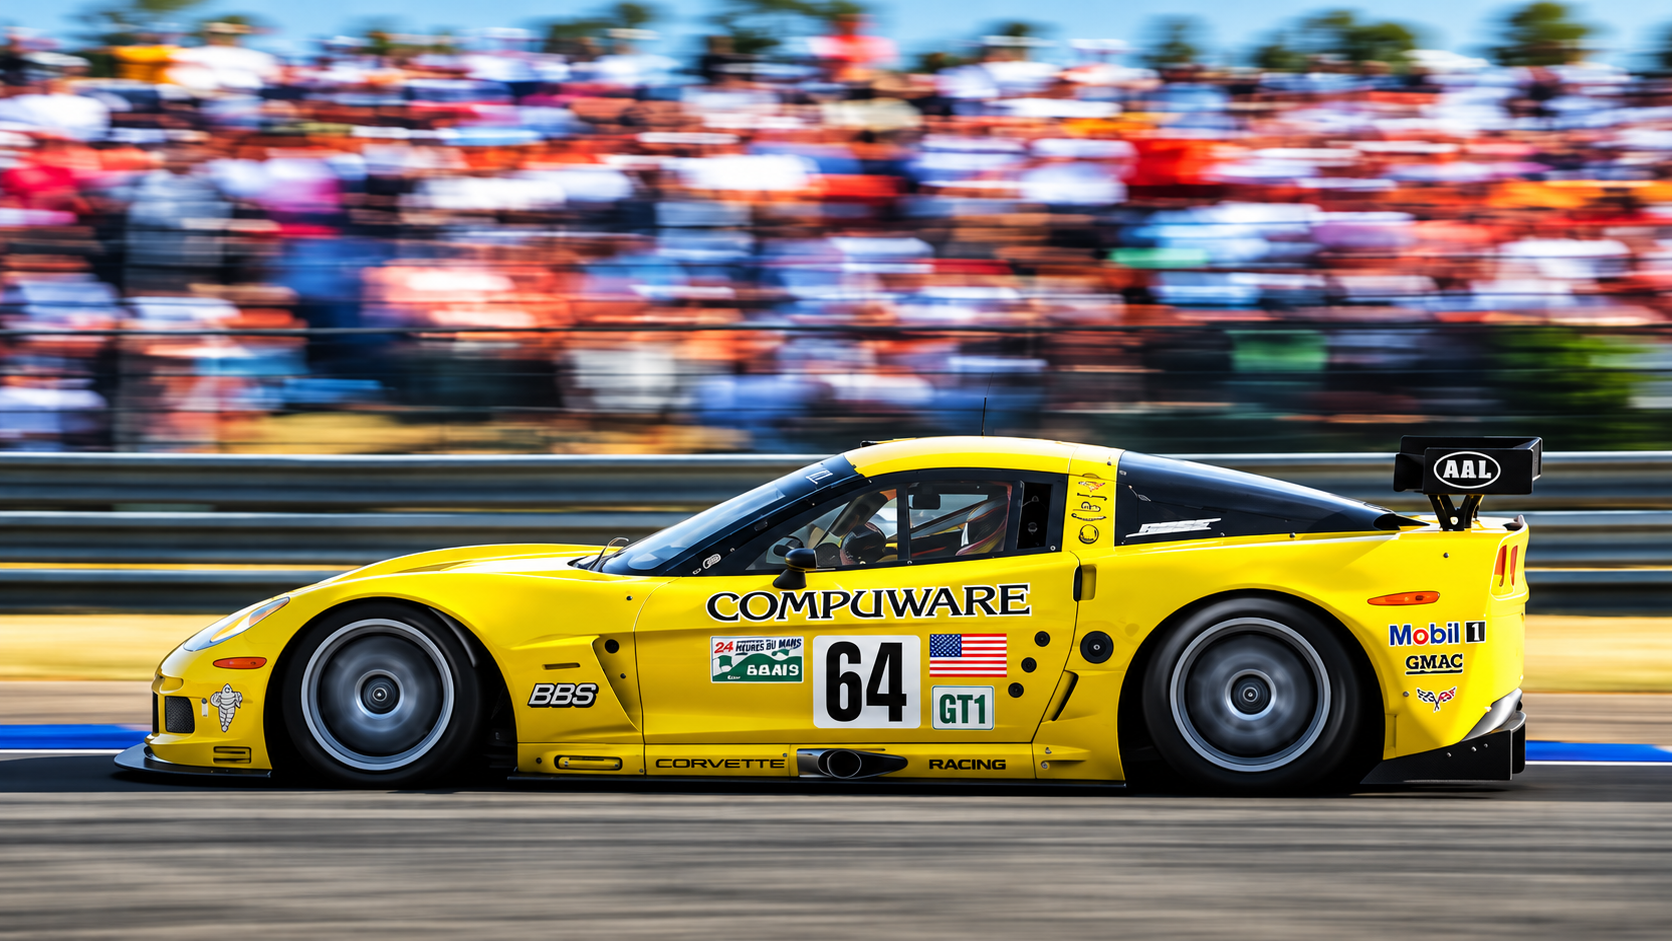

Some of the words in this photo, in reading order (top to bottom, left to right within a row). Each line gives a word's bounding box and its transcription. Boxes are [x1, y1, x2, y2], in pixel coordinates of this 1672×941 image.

[1443, 460, 1492, 479] AAL
[707, 584, 1031, 621] COMPUWARE
[1389, 622, 1460, 646] Mobil
[1469, 622, 1482, 641] 1
[714, 641, 734, 654] 24
[1405, 653, 1463, 670] GMAC
[826, 641, 907, 722] 64
[527, 682, 599, 708] BBS
[939, 693, 986, 724] GT1
[656, 758, 785, 769] CORVETTE
[929, 759, 1007, 770] RACING
